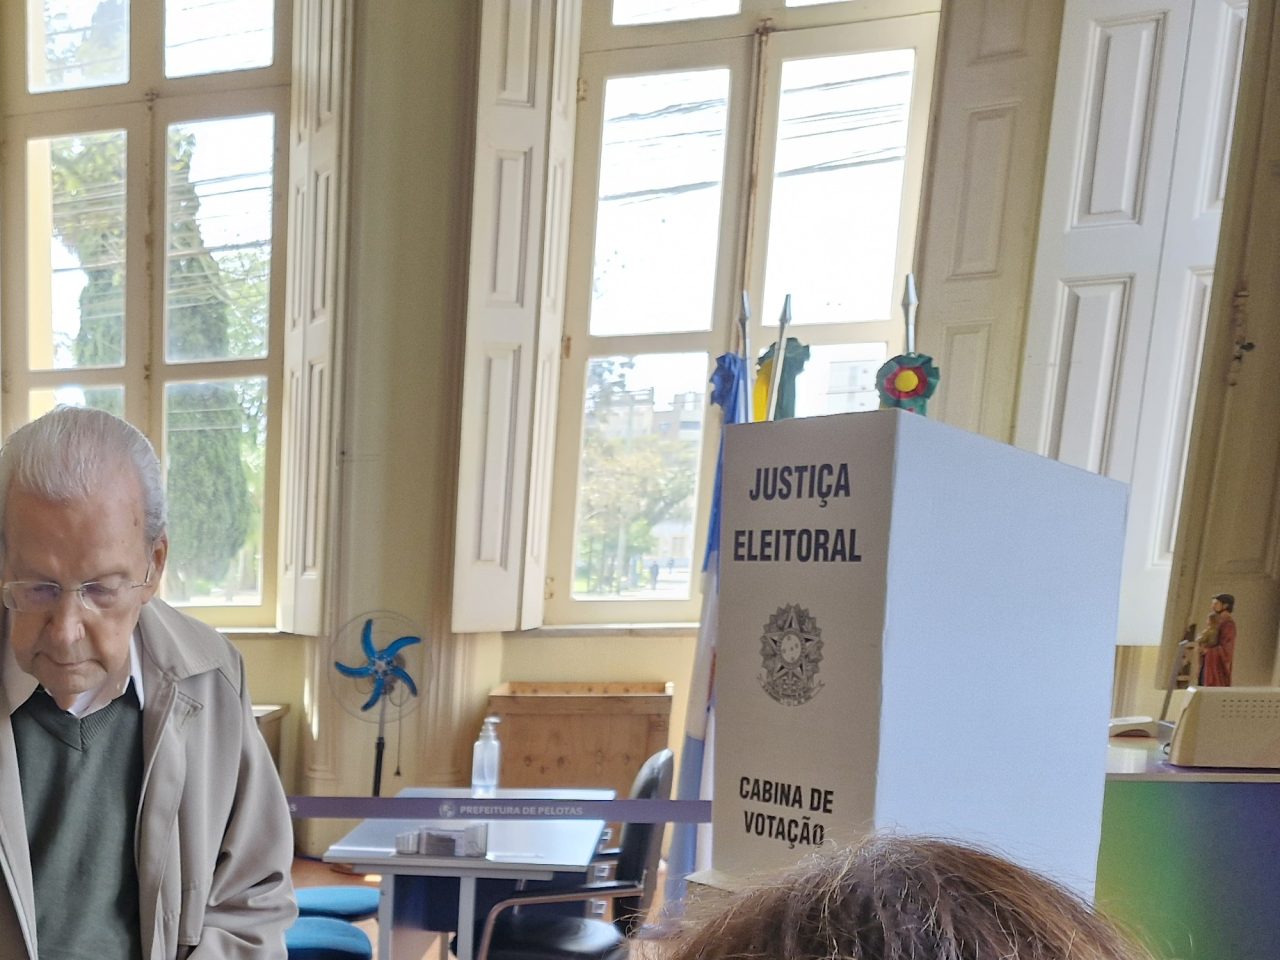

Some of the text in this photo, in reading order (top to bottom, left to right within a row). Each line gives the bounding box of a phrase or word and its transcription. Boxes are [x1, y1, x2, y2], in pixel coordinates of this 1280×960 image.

[749, 463, 851, 508] JUSTIÇA
[733, 528, 862, 562] ELEITORAL
[460, 804, 583, 816] PREFEITURA DE PELOTAS
[739, 777, 834, 814] CABINA DE
[744, 810, 825, 850] VOTAÇÃO
